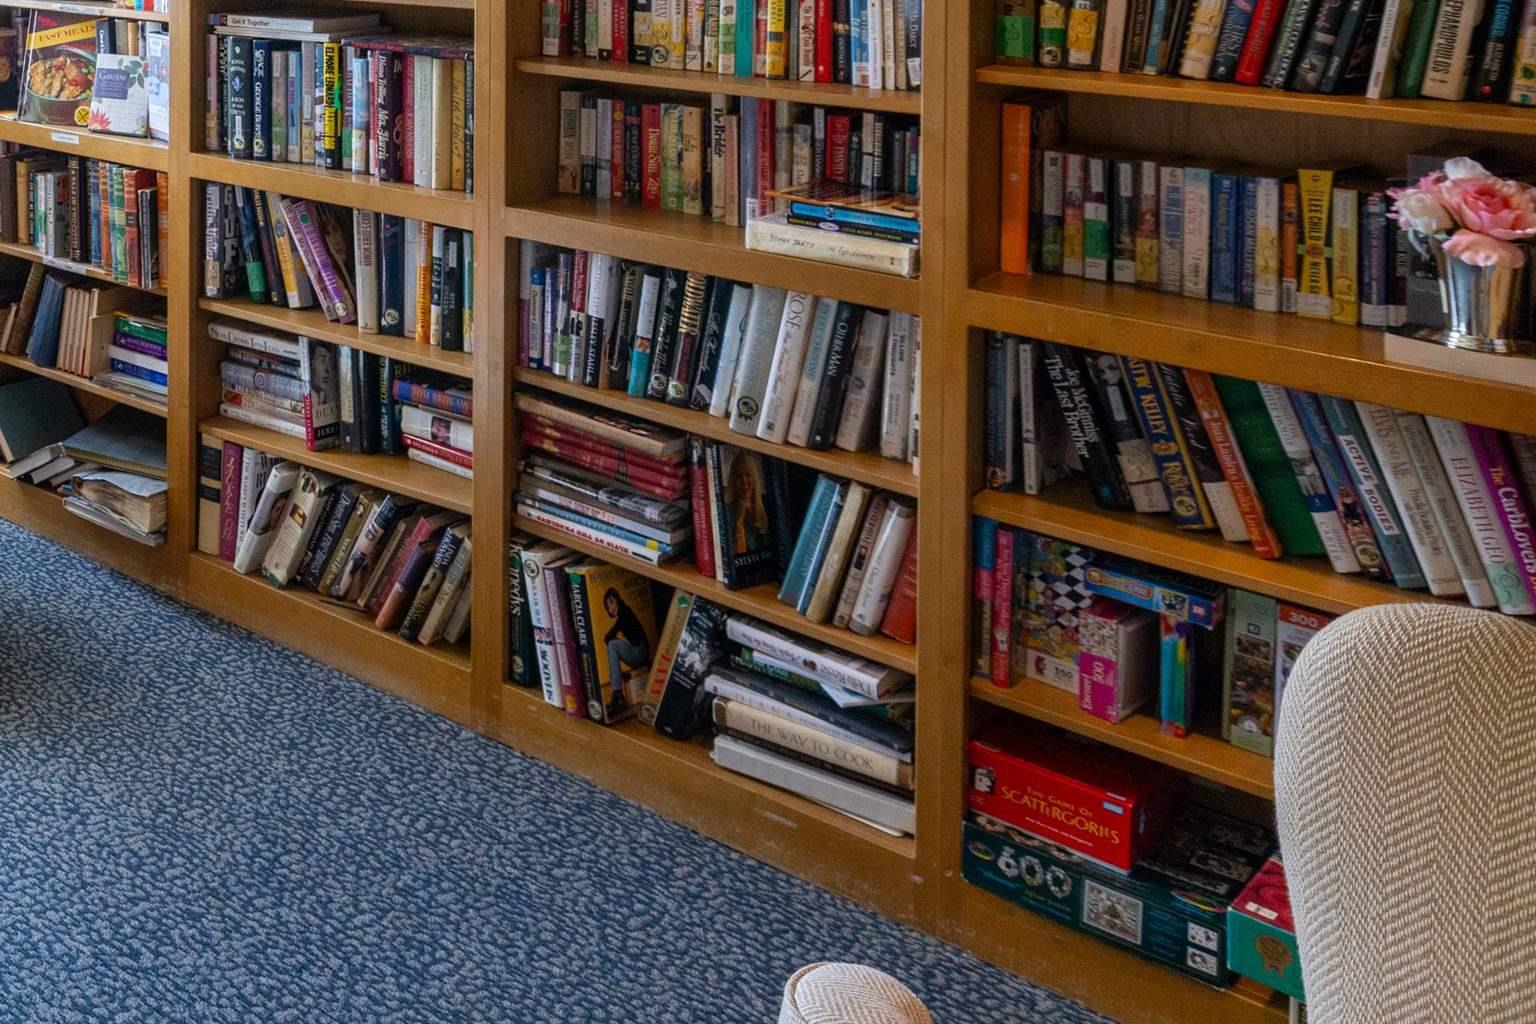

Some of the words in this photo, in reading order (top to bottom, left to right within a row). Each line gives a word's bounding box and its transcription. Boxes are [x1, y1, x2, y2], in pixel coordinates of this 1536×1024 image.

[909, 25, 919, 48] DARCY
[1226, 25, 1245, 57] FIRST
[325, 46, 336, 76] ELMORE
[378, 55, 387, 79] Diana
[325, 77, 336, 107] LEONARD
[378, 108, 389, 127] Mrs.
[713, 108, 723, 124] The
[377, 127, 390, 160] Harris
[713, 125, 726, 158] Bridge
[832, 146, 844, 175] DAVID
[1244, 208, 1254, 233] SUSAN
[1309, 198, 1323, 215] LEE
[1310, 216, 1324, 241] CHILD
[786, 292, 807, 329] ROSE
[827, 352, 842, 377] MAN
[1043, 355, 1067, 380] The
[1054, 382, 1074, 407] Last
[1065, 368, 1081, 386] Joe
[1073, 388, 1100, 443] McGinniss
[1140, 394, 1166, 435] KELLEY
[1063, 411, 1090, 458] Brother
[1368, 409, 1396, 438] ELVIS
[1386, 462, 1412, 480] ME
[1344, 438, 1373, 482] ACTIVE
[1364, 487, 1395, 533] BODIES
[1451, 457, 1492, 533] ELIZABETH
[1488, 466, 1506, 486] The
[1499, 487, 1536, 574] CarbLovers
[577, 616, 588, 647] CLARK
[1289, 612, 1318, 626] 300
[752, 719, 774, 733] THE
[777, 728, 808, 747] WAY
[812, 741, 830, 755] TO
[833, 748, 874, 771] COOK
[1001, 785, 1120, 844] SCATTERGORIES
[997, 846, 1073, 898] 600
